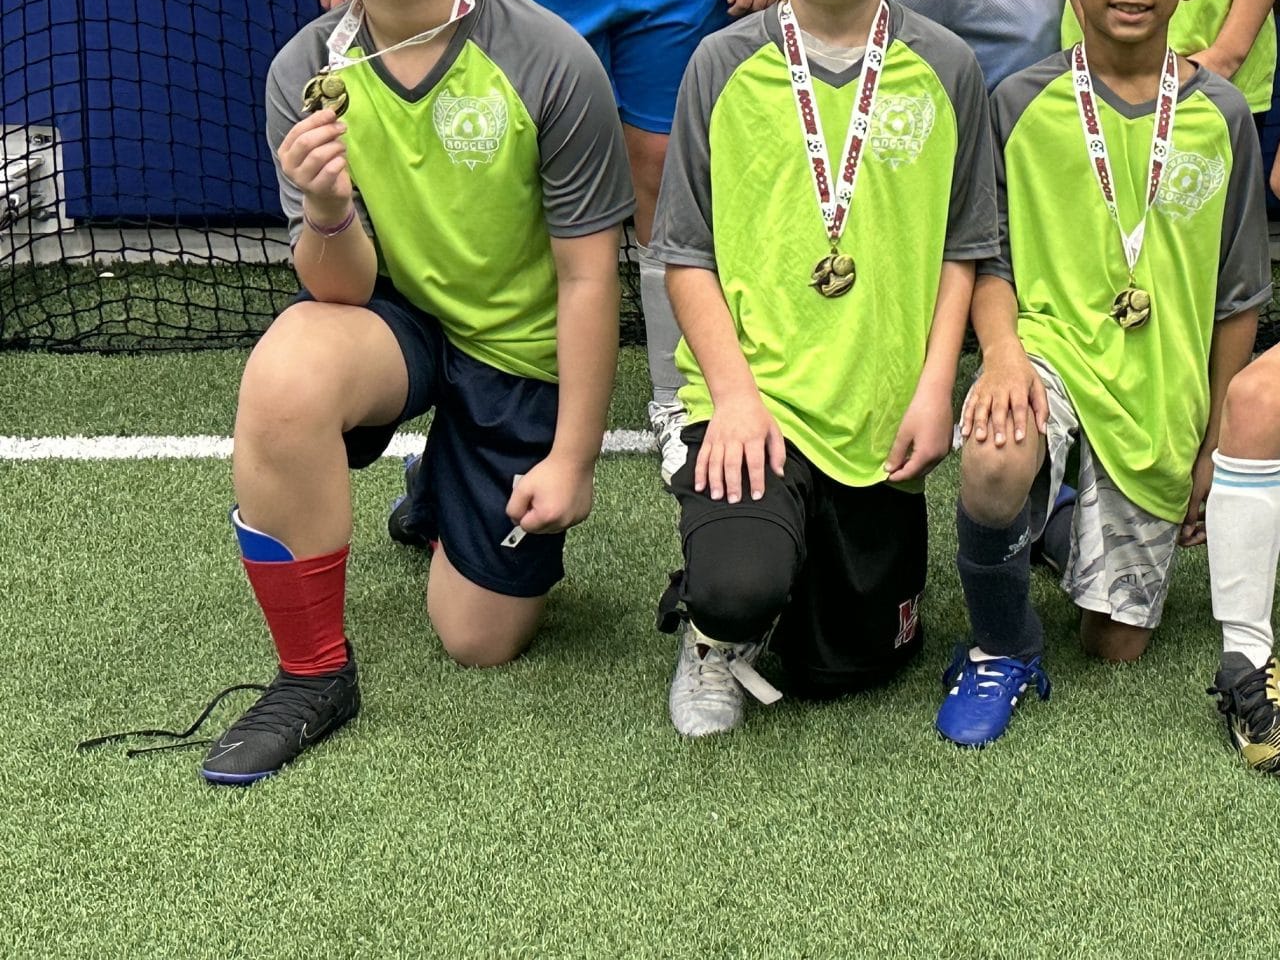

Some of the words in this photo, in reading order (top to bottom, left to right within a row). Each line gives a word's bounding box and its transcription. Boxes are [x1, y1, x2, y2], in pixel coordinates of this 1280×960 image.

[784, 22, 802, 66] SOCCER
[797, 89, 817, 135] SOCCER
[859, 66, 878, 116] SOCCER
[1080, 91, 1099, 136] SOCCER
[1157, 94, 1172, 141] SOCCER
[446, 140, 495, 150] SOCCER
[843, 135, 862, 185] SOCCER
[872, 138, 919, 149] SOCCER
[812, 157, 830, 203] SOCCER
